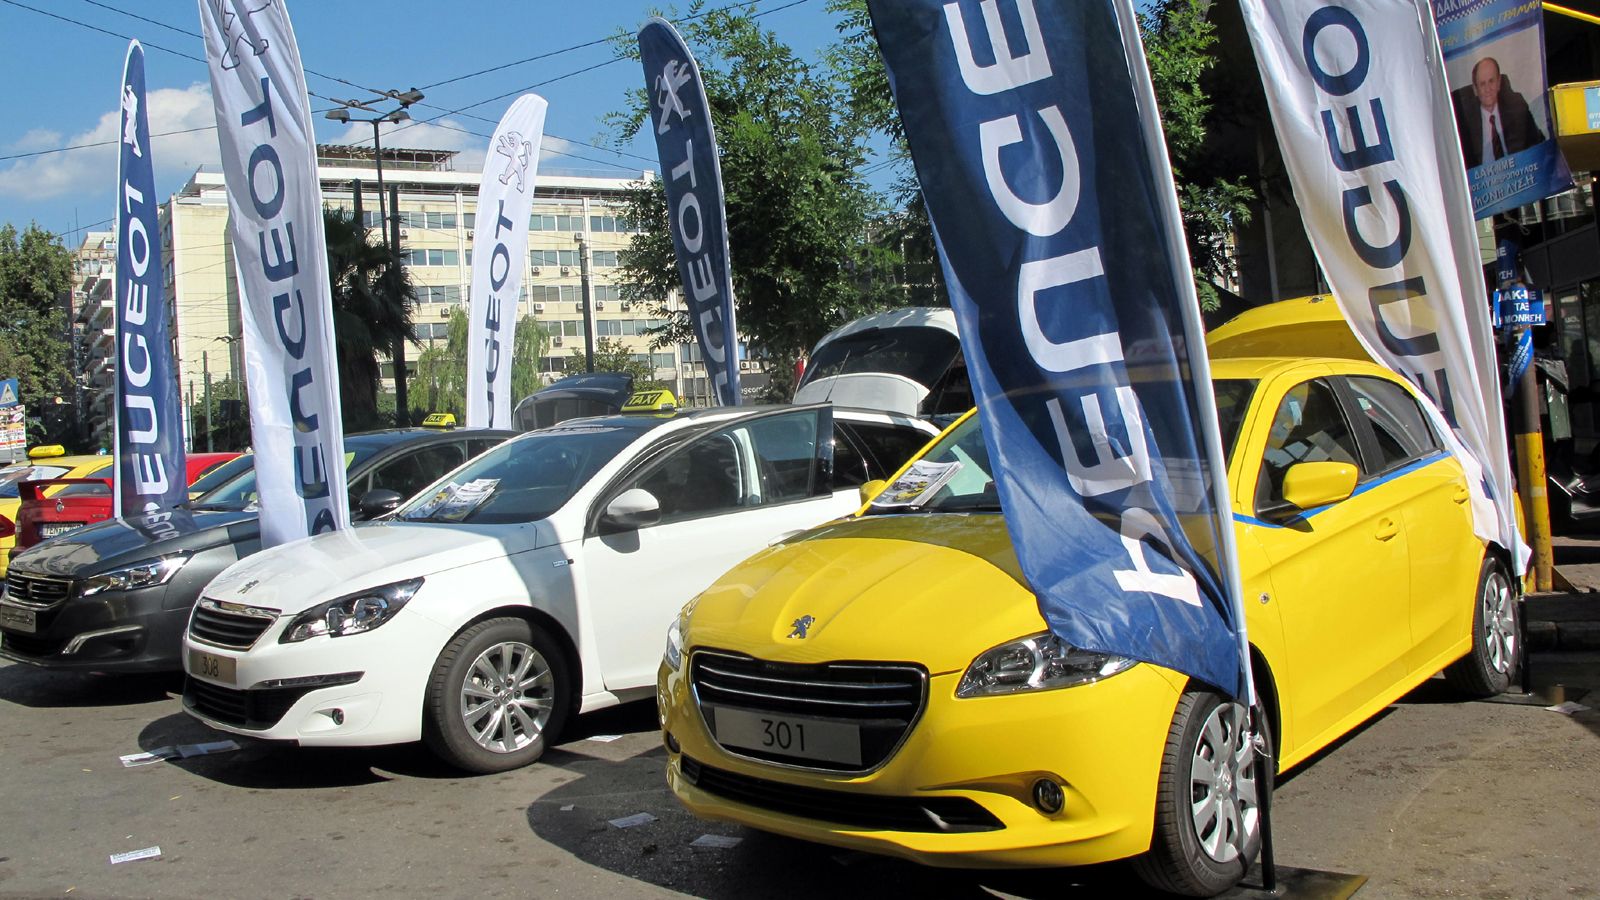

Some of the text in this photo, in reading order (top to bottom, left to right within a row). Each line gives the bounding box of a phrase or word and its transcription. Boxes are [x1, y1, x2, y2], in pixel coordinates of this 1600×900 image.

[124, 179, 169, 513] EUGEOT
[629, 393, 661, 405] TAXI
[202, 656, 219, 677] 308
[761, 719, 804, 751] 301
